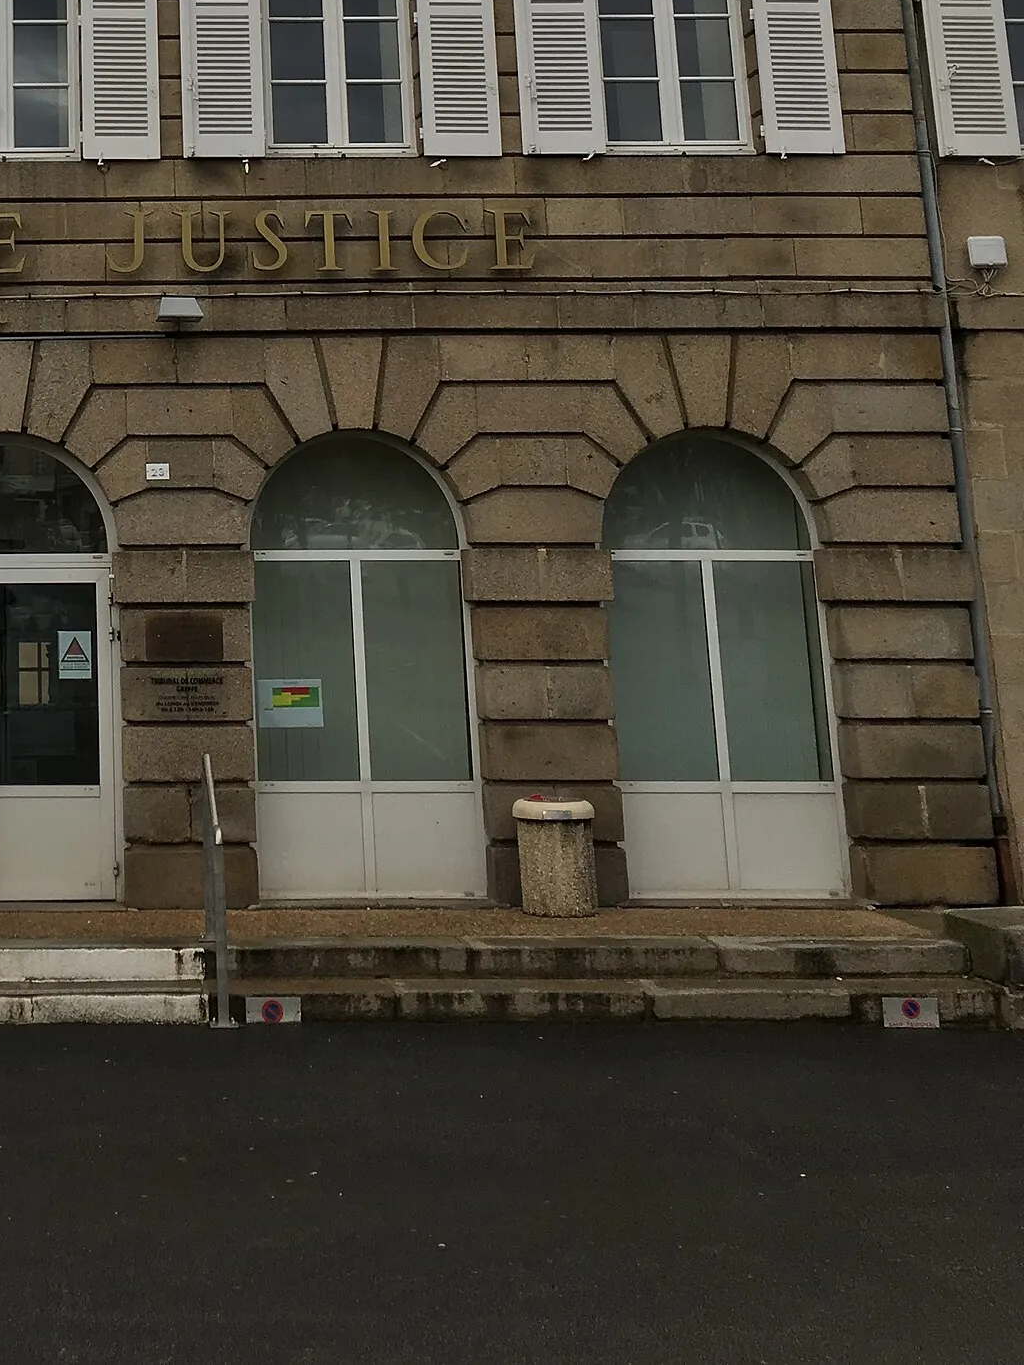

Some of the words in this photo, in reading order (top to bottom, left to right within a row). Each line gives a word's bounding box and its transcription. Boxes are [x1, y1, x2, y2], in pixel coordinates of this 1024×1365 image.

[105, 208, 537, 275] JUSTICE
[151, 467, 165, 477] 23
[151, 677, 180, 685] TRIBUNAL
[190, 677, 224, 685] COMMERCE
[176, 685, 198, 693] GREFFE
